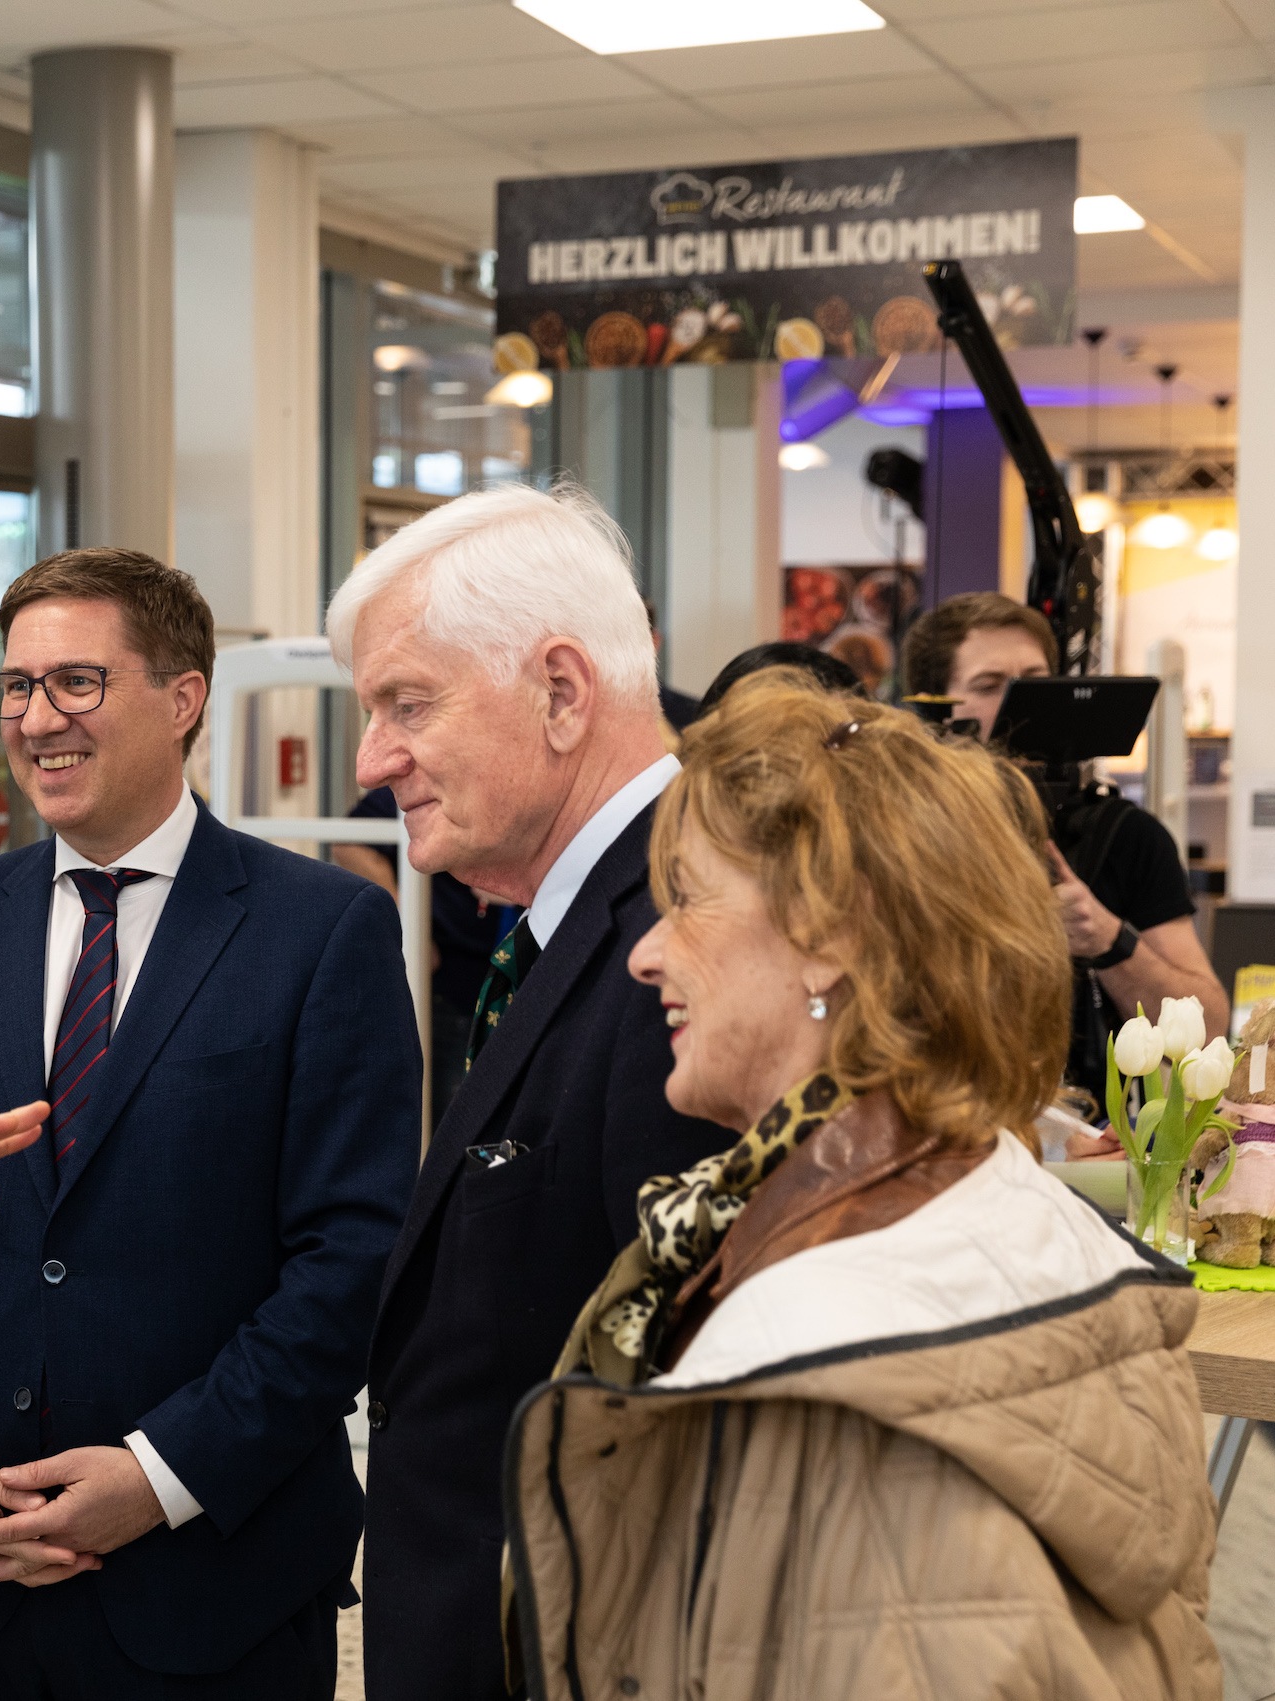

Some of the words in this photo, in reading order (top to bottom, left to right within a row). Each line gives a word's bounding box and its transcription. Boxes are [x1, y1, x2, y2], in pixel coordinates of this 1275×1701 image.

[710, 166, 905, 222] Restaurant
[527, 230, 727, 285] HERZLICH
[731, 208, 1042, 273] WILLKOMMEN!
